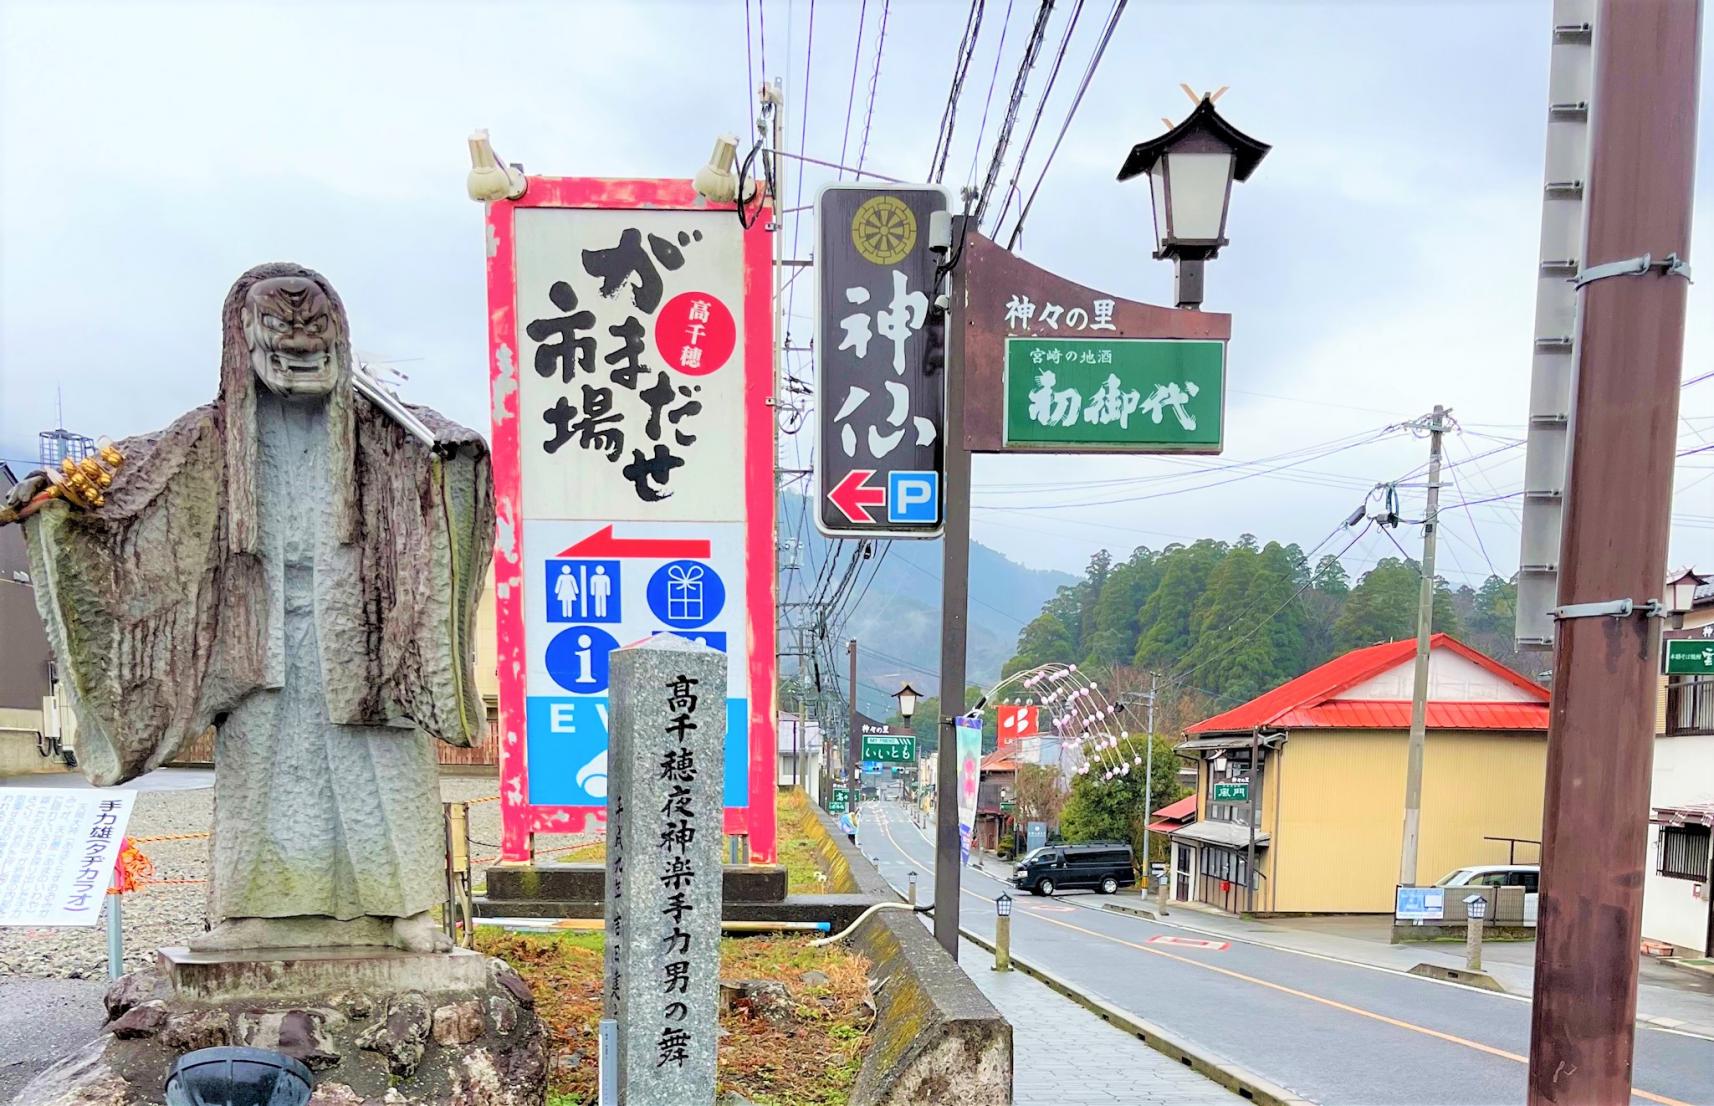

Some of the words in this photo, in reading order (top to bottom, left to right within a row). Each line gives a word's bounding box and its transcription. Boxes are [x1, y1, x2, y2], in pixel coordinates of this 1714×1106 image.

[1005, 295, 1116, 330] 神々の里
[526, 281, 625, 462] 市場
[581, 227, 703, 501] がまだせ
[834, 270, 937, 458] 神仙
[1030, 348, 1112, 364] 宮崎の地酒
[1028, 367, 1199, 431] 初御代
[897, 482, 932, 514] P
[865, 745, 910, 759] いいとも
